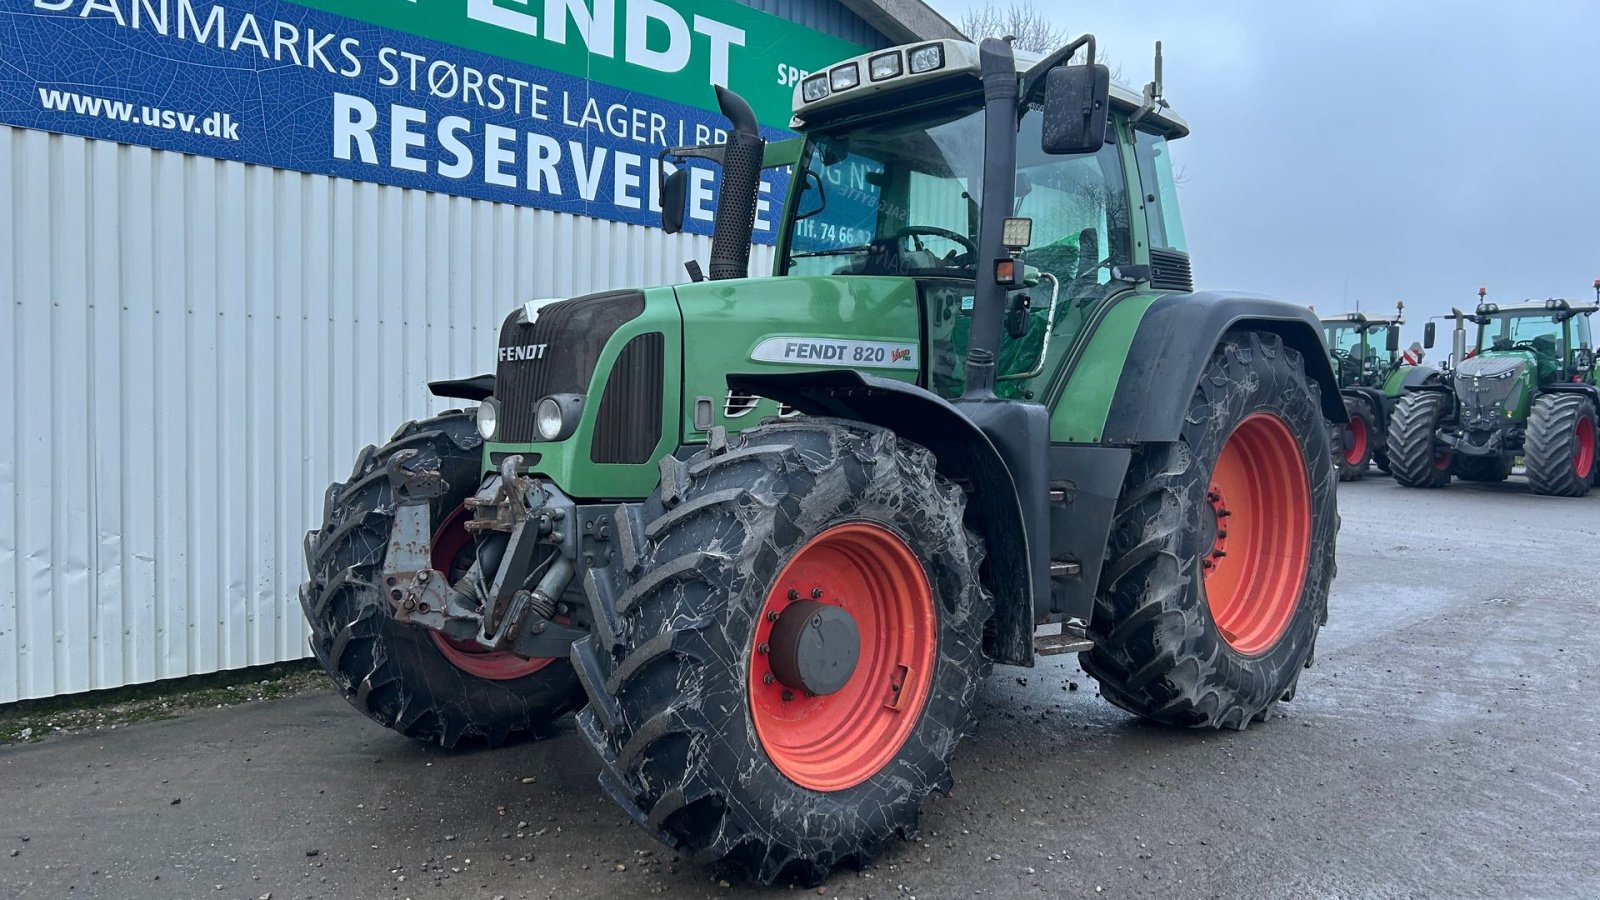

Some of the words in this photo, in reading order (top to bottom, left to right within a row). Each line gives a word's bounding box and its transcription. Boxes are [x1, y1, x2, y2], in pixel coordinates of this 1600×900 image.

[34, 0, 362, 78] ANMARKS
[378, 47, 548, 120] STØRSTE
[563, 91, 666, 147] LAGER
[38, 87, 240, 141] www.usv.dk
[796, 219, 817, 239] Tlf.
[820, 223, 836, 242] 74
[839, 226, 854, 243] 66
[499, 343, 548, 362] FENDT
[784, 342, 847, 361] FENDT
[853, 346, 885, 363] 820
